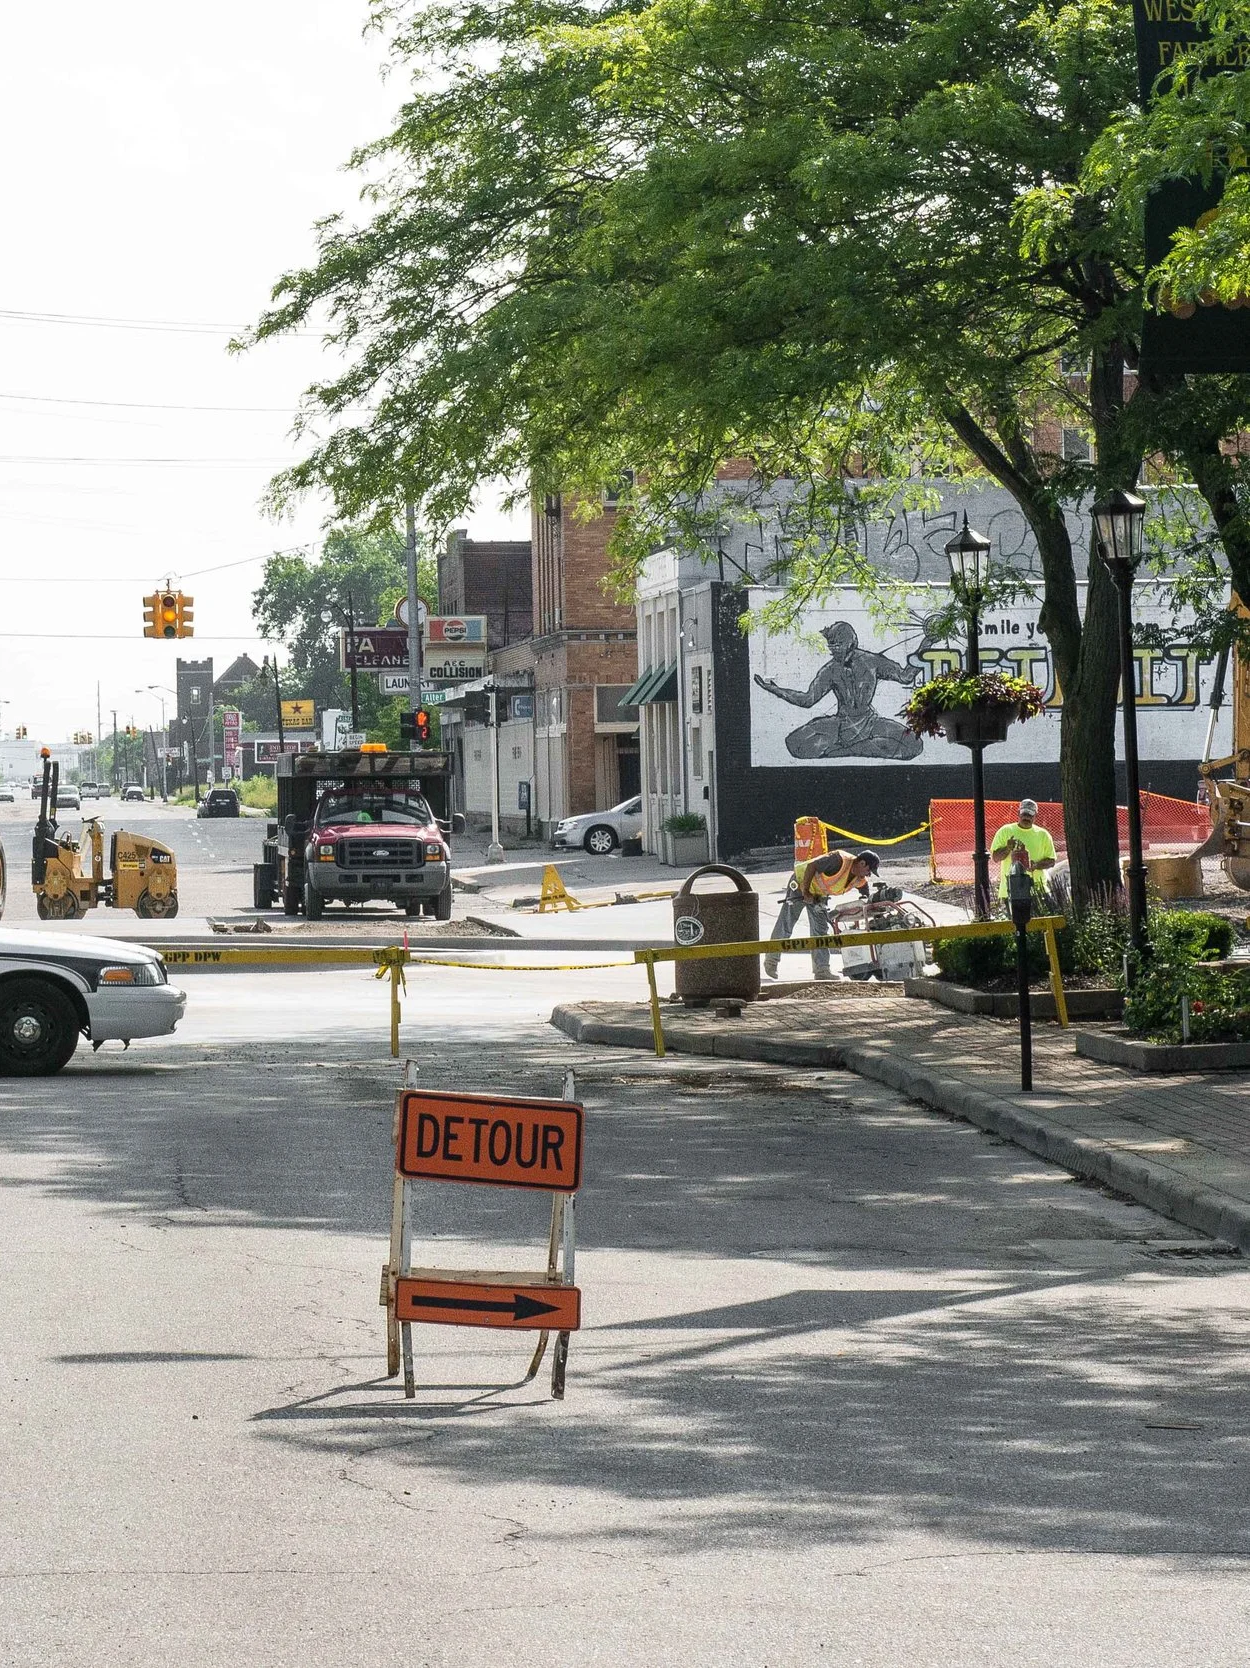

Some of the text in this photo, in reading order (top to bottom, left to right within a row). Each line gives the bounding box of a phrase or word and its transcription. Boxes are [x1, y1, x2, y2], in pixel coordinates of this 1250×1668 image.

[1158, 41, 1250, 66] FAER
[429, 666, 483, 679] COLLISION
[425, 693, 443, 703] Alter
[421, 727, 427, 738] 2
[117, 851, 137, 860] C425
[159, 855, 170, 863] CAT
[165, 951, 222, 963] GPP DPW
[415, 1112, 566, 1172] DETOUR
